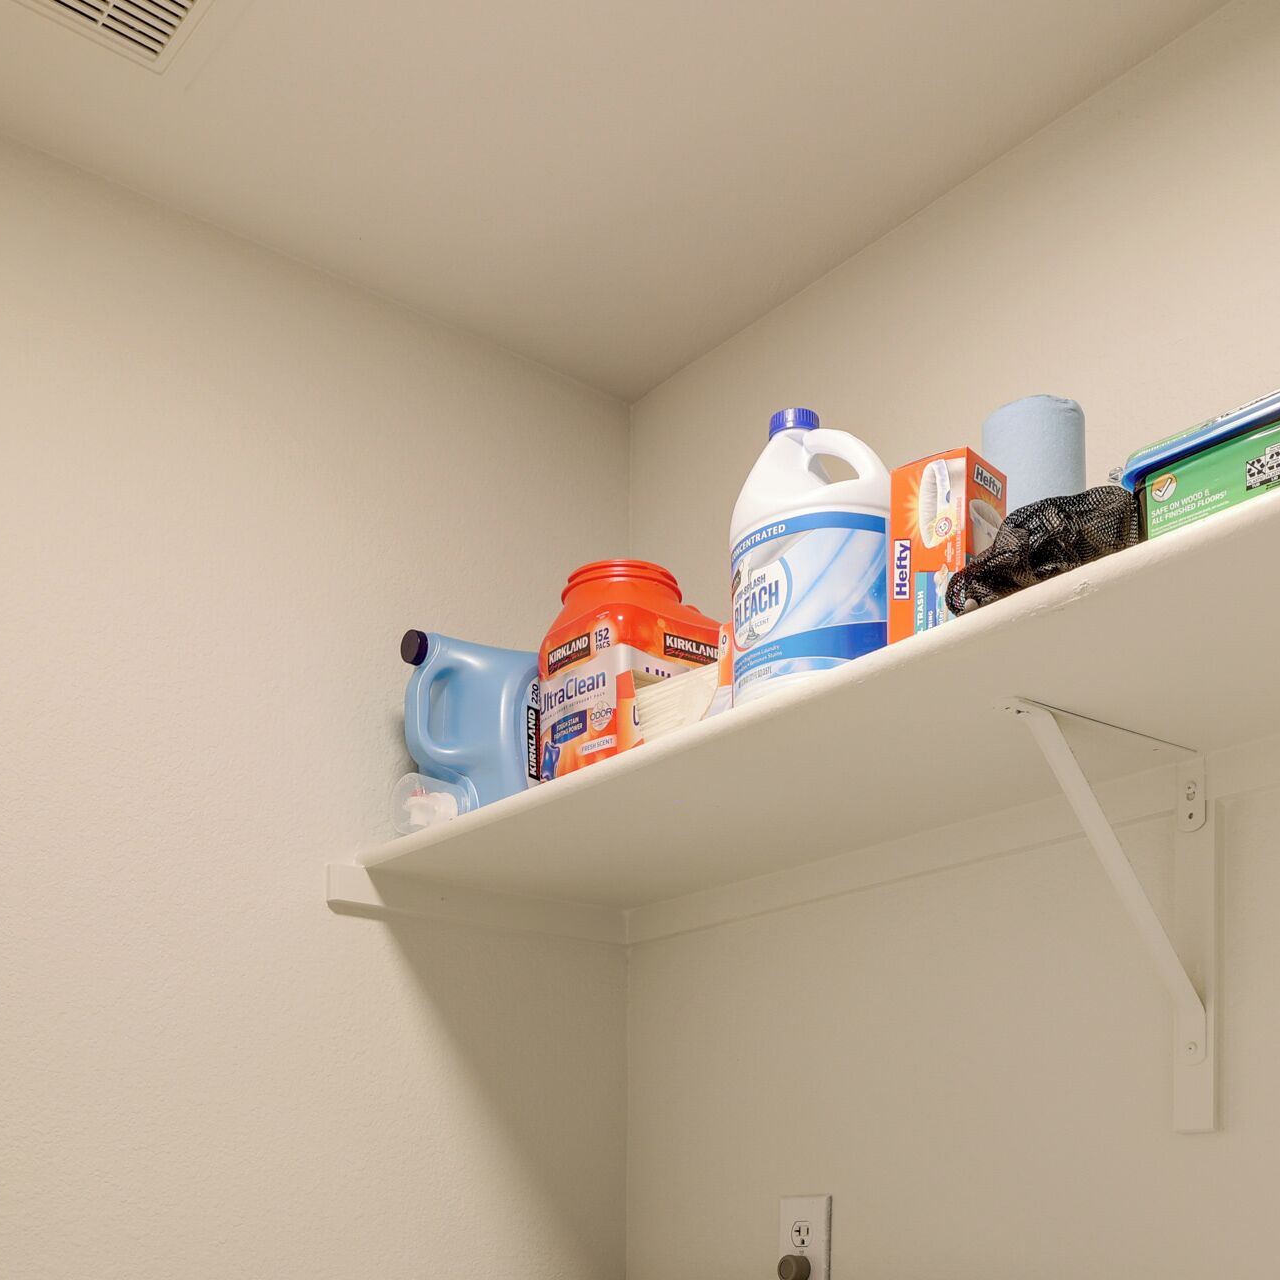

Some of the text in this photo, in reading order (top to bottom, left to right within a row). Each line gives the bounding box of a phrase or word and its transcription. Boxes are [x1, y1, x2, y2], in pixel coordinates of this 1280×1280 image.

[976, 467, 1001, 497] Hefty
[1151, 505, 1169, 518] SAFE
[1169, 500, 1181, 511] ON
[1181, 492, 1203, 507] WOOD
[1151, 515, 1165, 527] ALL
[1165, 503, 1196, 521] FINISHED
[1197, 490, 1228, 510] FLOORS!
[895, 543, 911, 597] Hefty
[735, 579, 779, 633] BLEACH
[594, 627, 610, 644] 152
[595, 641, 611, 652] PACS
[666, 634, 720, 659] KIRKLAND
[548, 636, 589, 665] KIRKLAND
[531, 684, 539, 704] 220
[540, 671, 606, 716] UltraClean
[590, 707, 612, 721] ODOR
[528, 709, 537, 777] KIRKLAND
[582, 737, 613, 752] FRESH SCENT
